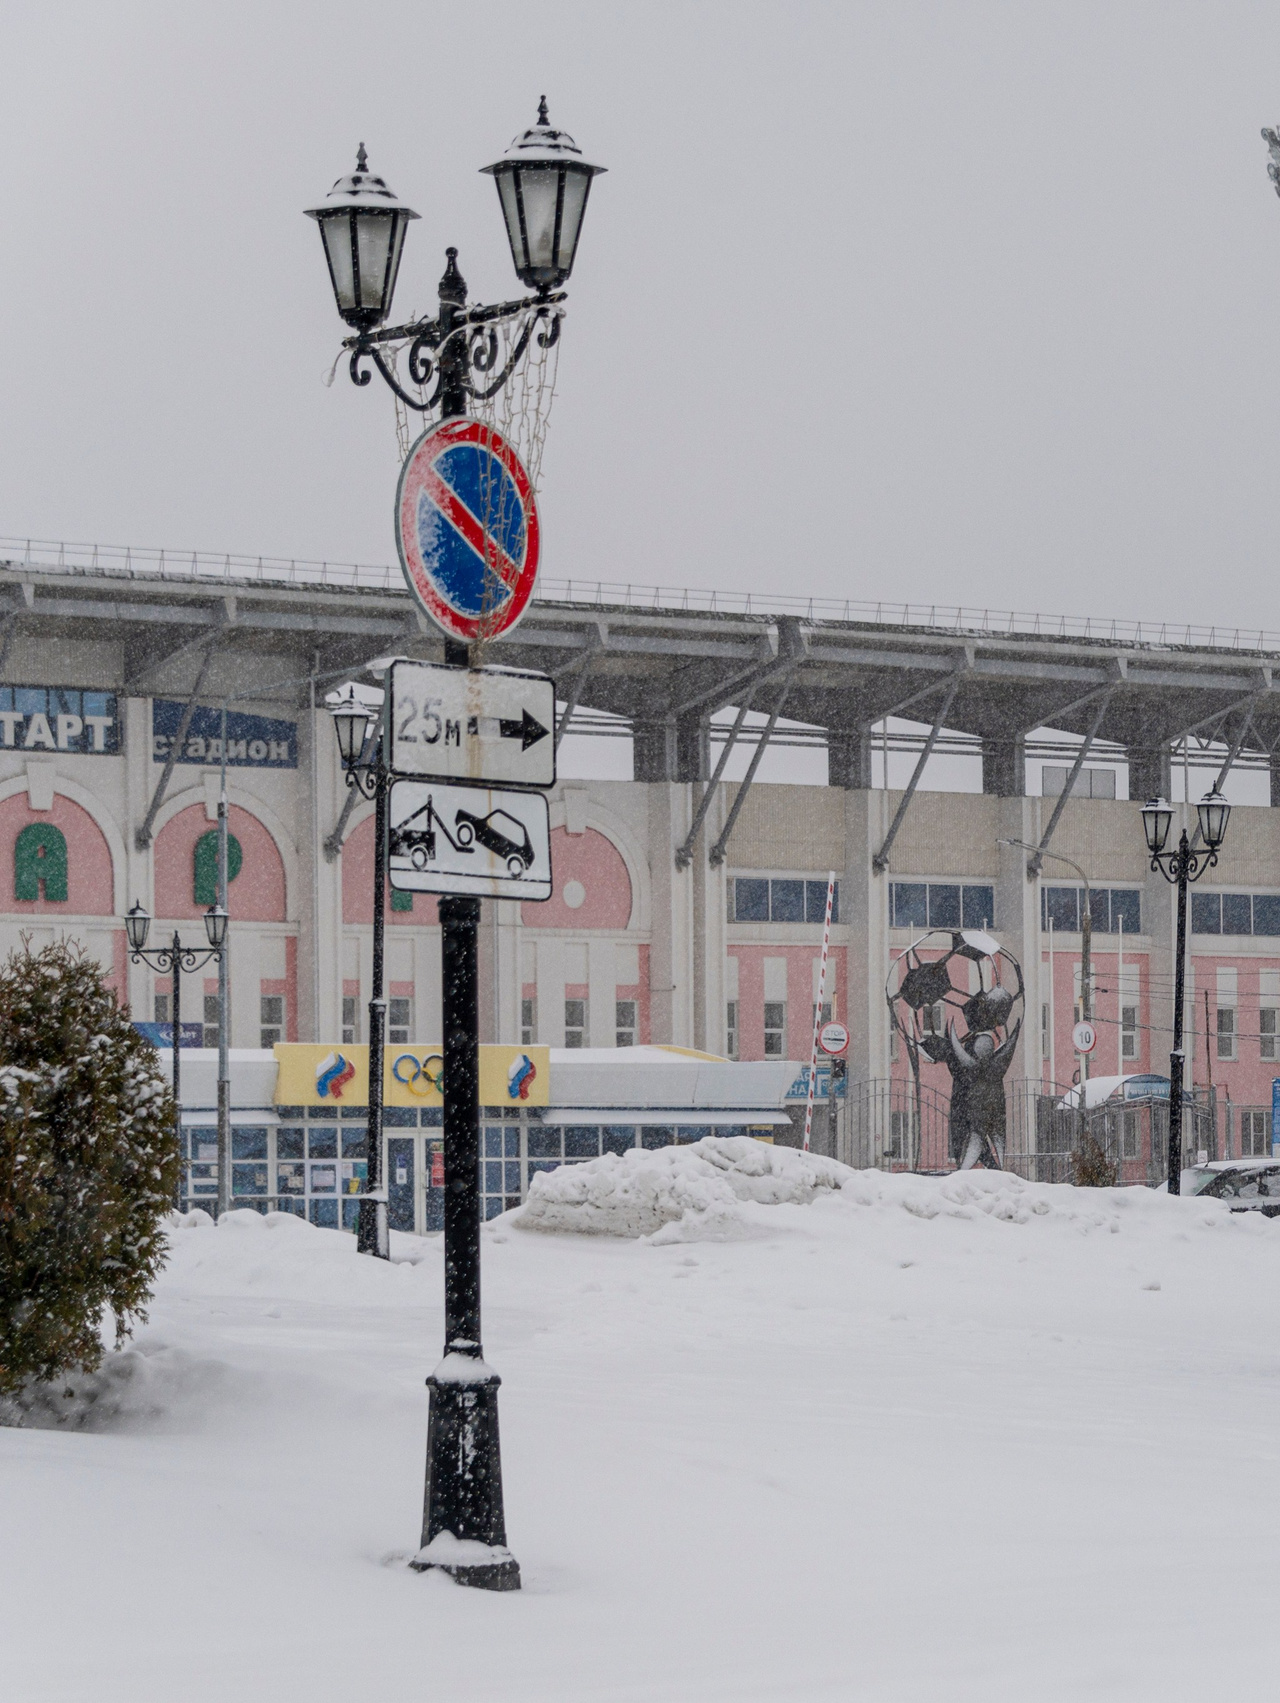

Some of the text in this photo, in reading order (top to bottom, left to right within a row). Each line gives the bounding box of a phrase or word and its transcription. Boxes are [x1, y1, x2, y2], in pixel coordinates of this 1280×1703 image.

[0, 711, 113, 750] ТАРТ
[825, 1029, 844, 1037] STOP
[1079, 1031, 1091, 1044] 10
